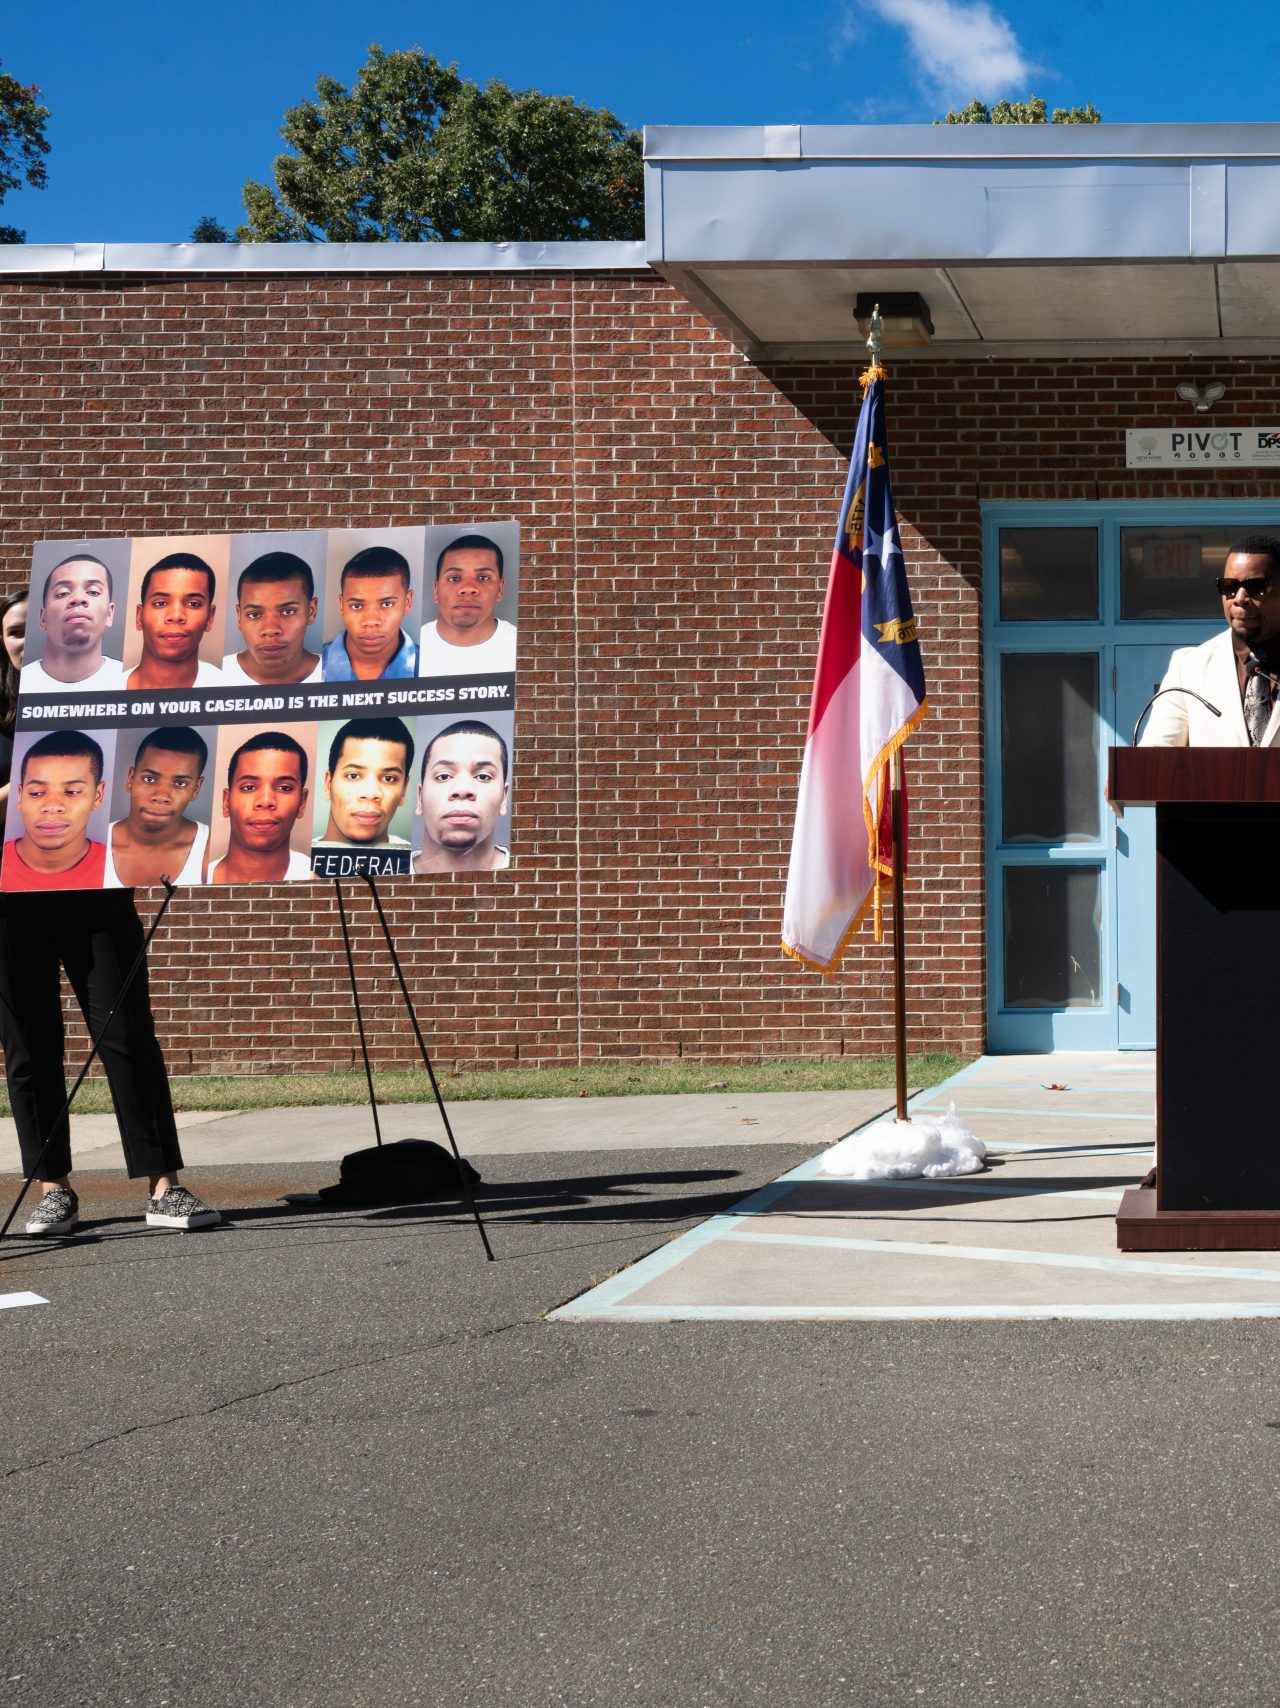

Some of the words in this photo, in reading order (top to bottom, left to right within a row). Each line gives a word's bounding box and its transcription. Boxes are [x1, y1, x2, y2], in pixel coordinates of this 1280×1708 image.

[1172, 432, 1242, 451] PIVOT
[1153, 544, 1192, 575] EXIT
[22, 702, 127, 719] SOMEWHERE
[131, 702, 155, 715] ON
[159, 700, 201, 715] YOUR
[204, 696, 284, 713] CASELOAD
[288, 697, 304, 709] IS
[308, 694, 338, 708] THE
[342, 692, 385, 707] NEXT
[387, 688, 455, 704] SUCCESS
[459, 685, 510, 700] STORY.
[313, 855, 405, 876] FEDERAL
